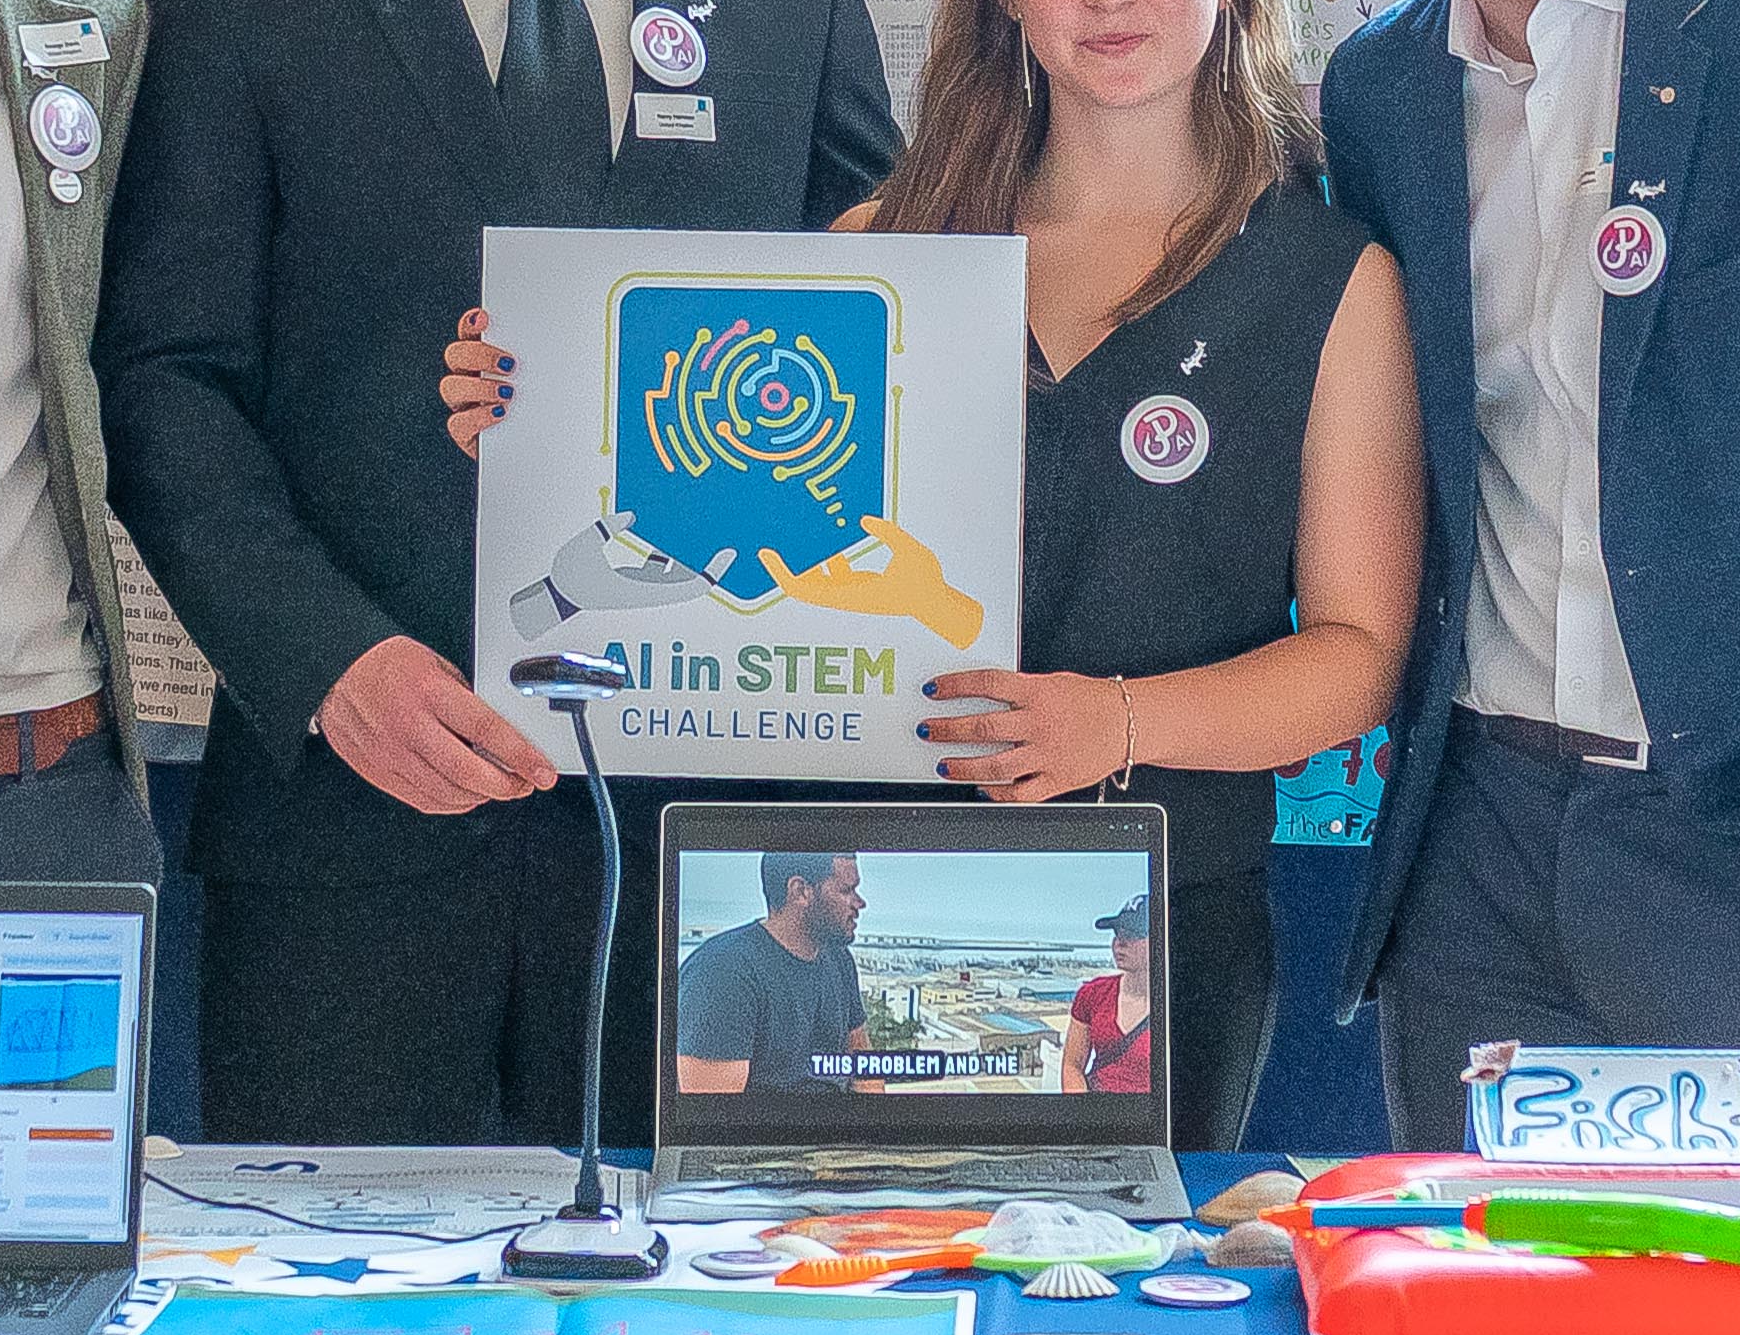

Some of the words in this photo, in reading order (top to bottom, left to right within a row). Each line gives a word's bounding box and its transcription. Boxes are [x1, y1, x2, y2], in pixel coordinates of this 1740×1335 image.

[144, 607, 167, 620] like
[125, 630, 148, 644] hat
[671, 642, 720, 691] in
[736, 646, 897, 696] STEM
[140, 681, 159, 692] we
[163, 682, 198, 696] need
[138, 701, 179, 717] berts)
[621, 707, 862, 742] CHALLENGE
[812, 1055, 852, 1075] THIS
[857, 1055, 940, 1075] PROBLEM
[945, 1055, 980, 1075] AND
[986, 1055, 1018, 1075] THE
